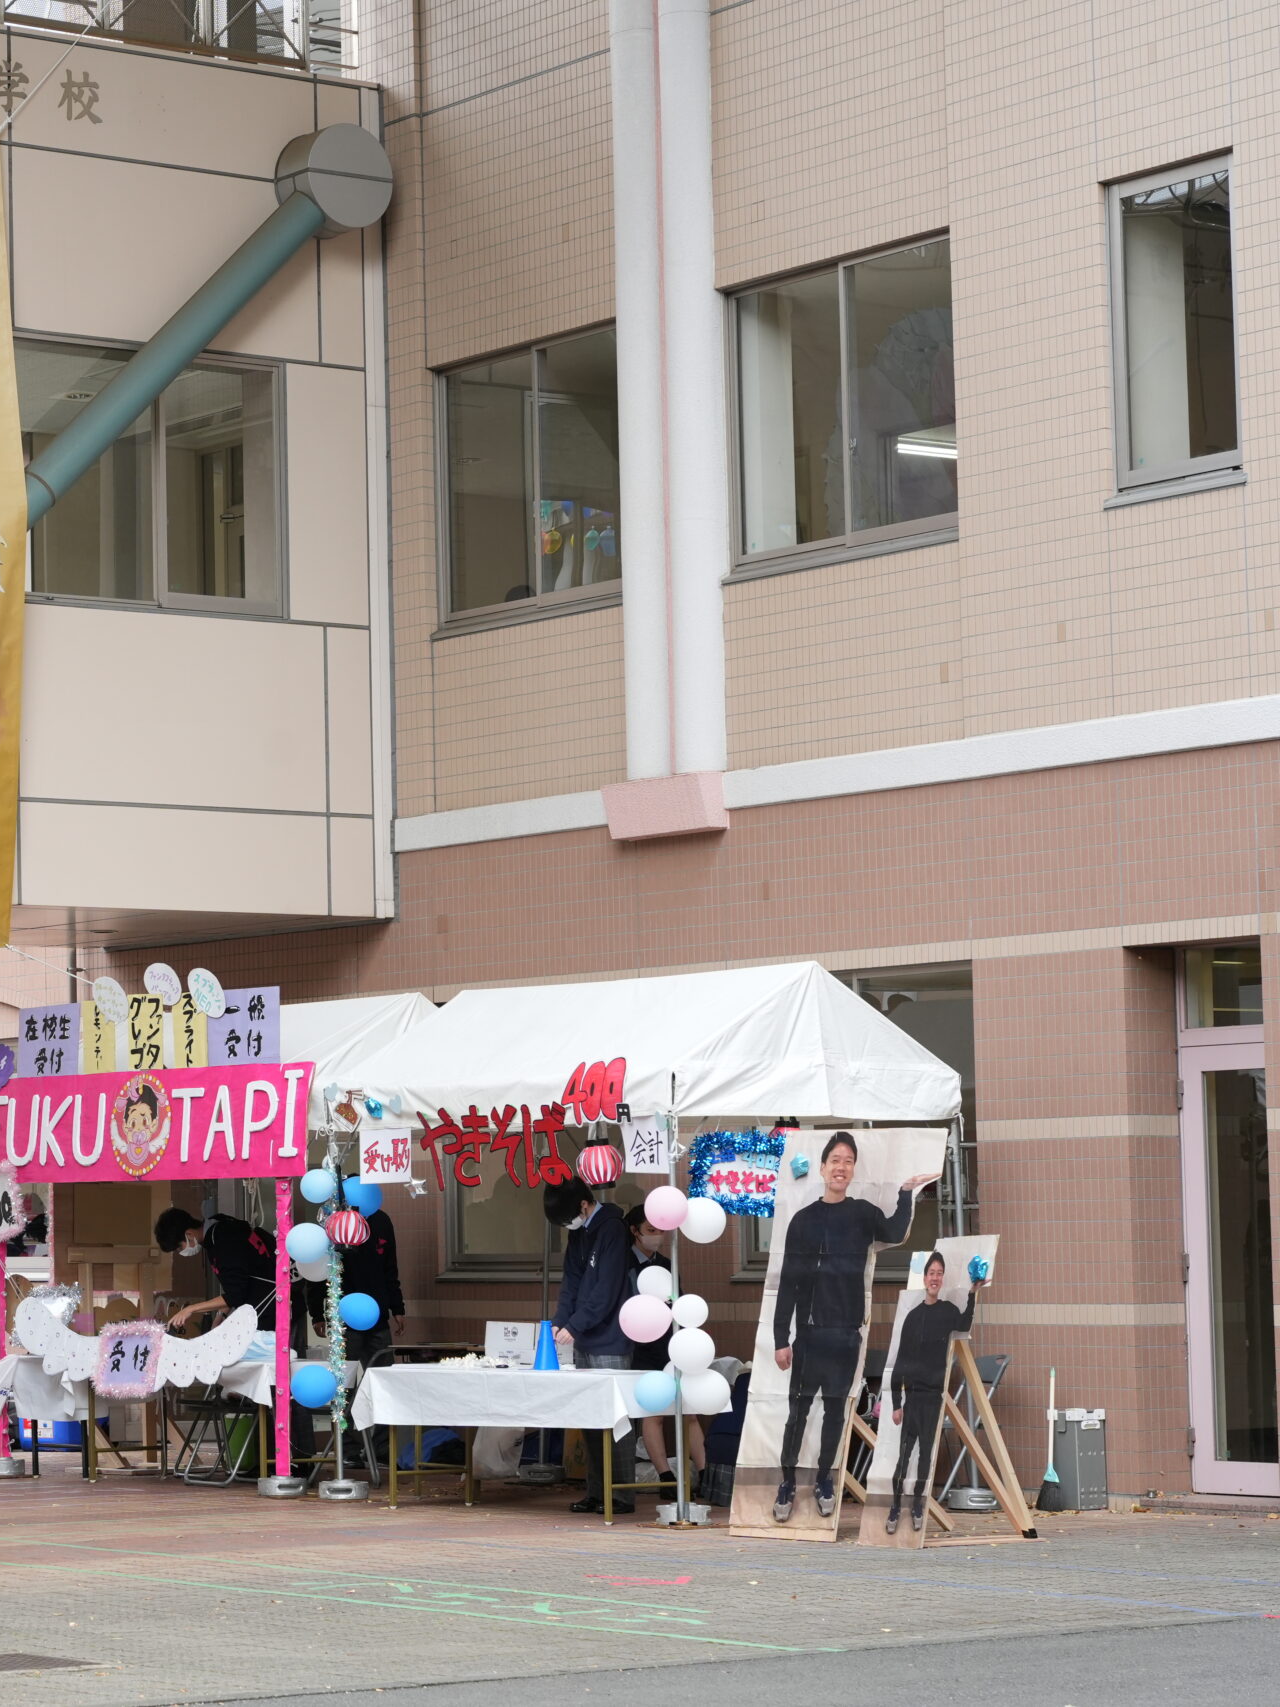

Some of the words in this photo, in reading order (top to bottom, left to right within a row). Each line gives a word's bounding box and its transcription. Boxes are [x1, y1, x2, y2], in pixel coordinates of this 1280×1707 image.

[194, 988, 211, 1012] NEO
[25, 1013, 70, 1042] 在校生
[130, 997, 147, 1069] グレープ
[147, 998, 162, 1069] ファンタ
[183, 993, 197, 1067] スプライト
[225, 1029, 262, 1058] 受付
[34, 1048, 64, 1075] 受付
[172, 1069, 305, 1162] TAPI
[363, 1138, 410, 1174] 受け取り
[416, 1101, 573, 1191] やきそば
[630, 1129, 663, 1166] 会計
[708, 1170, 776, 1194] やきそば
[109, 1340, 151, 1372] 受付
